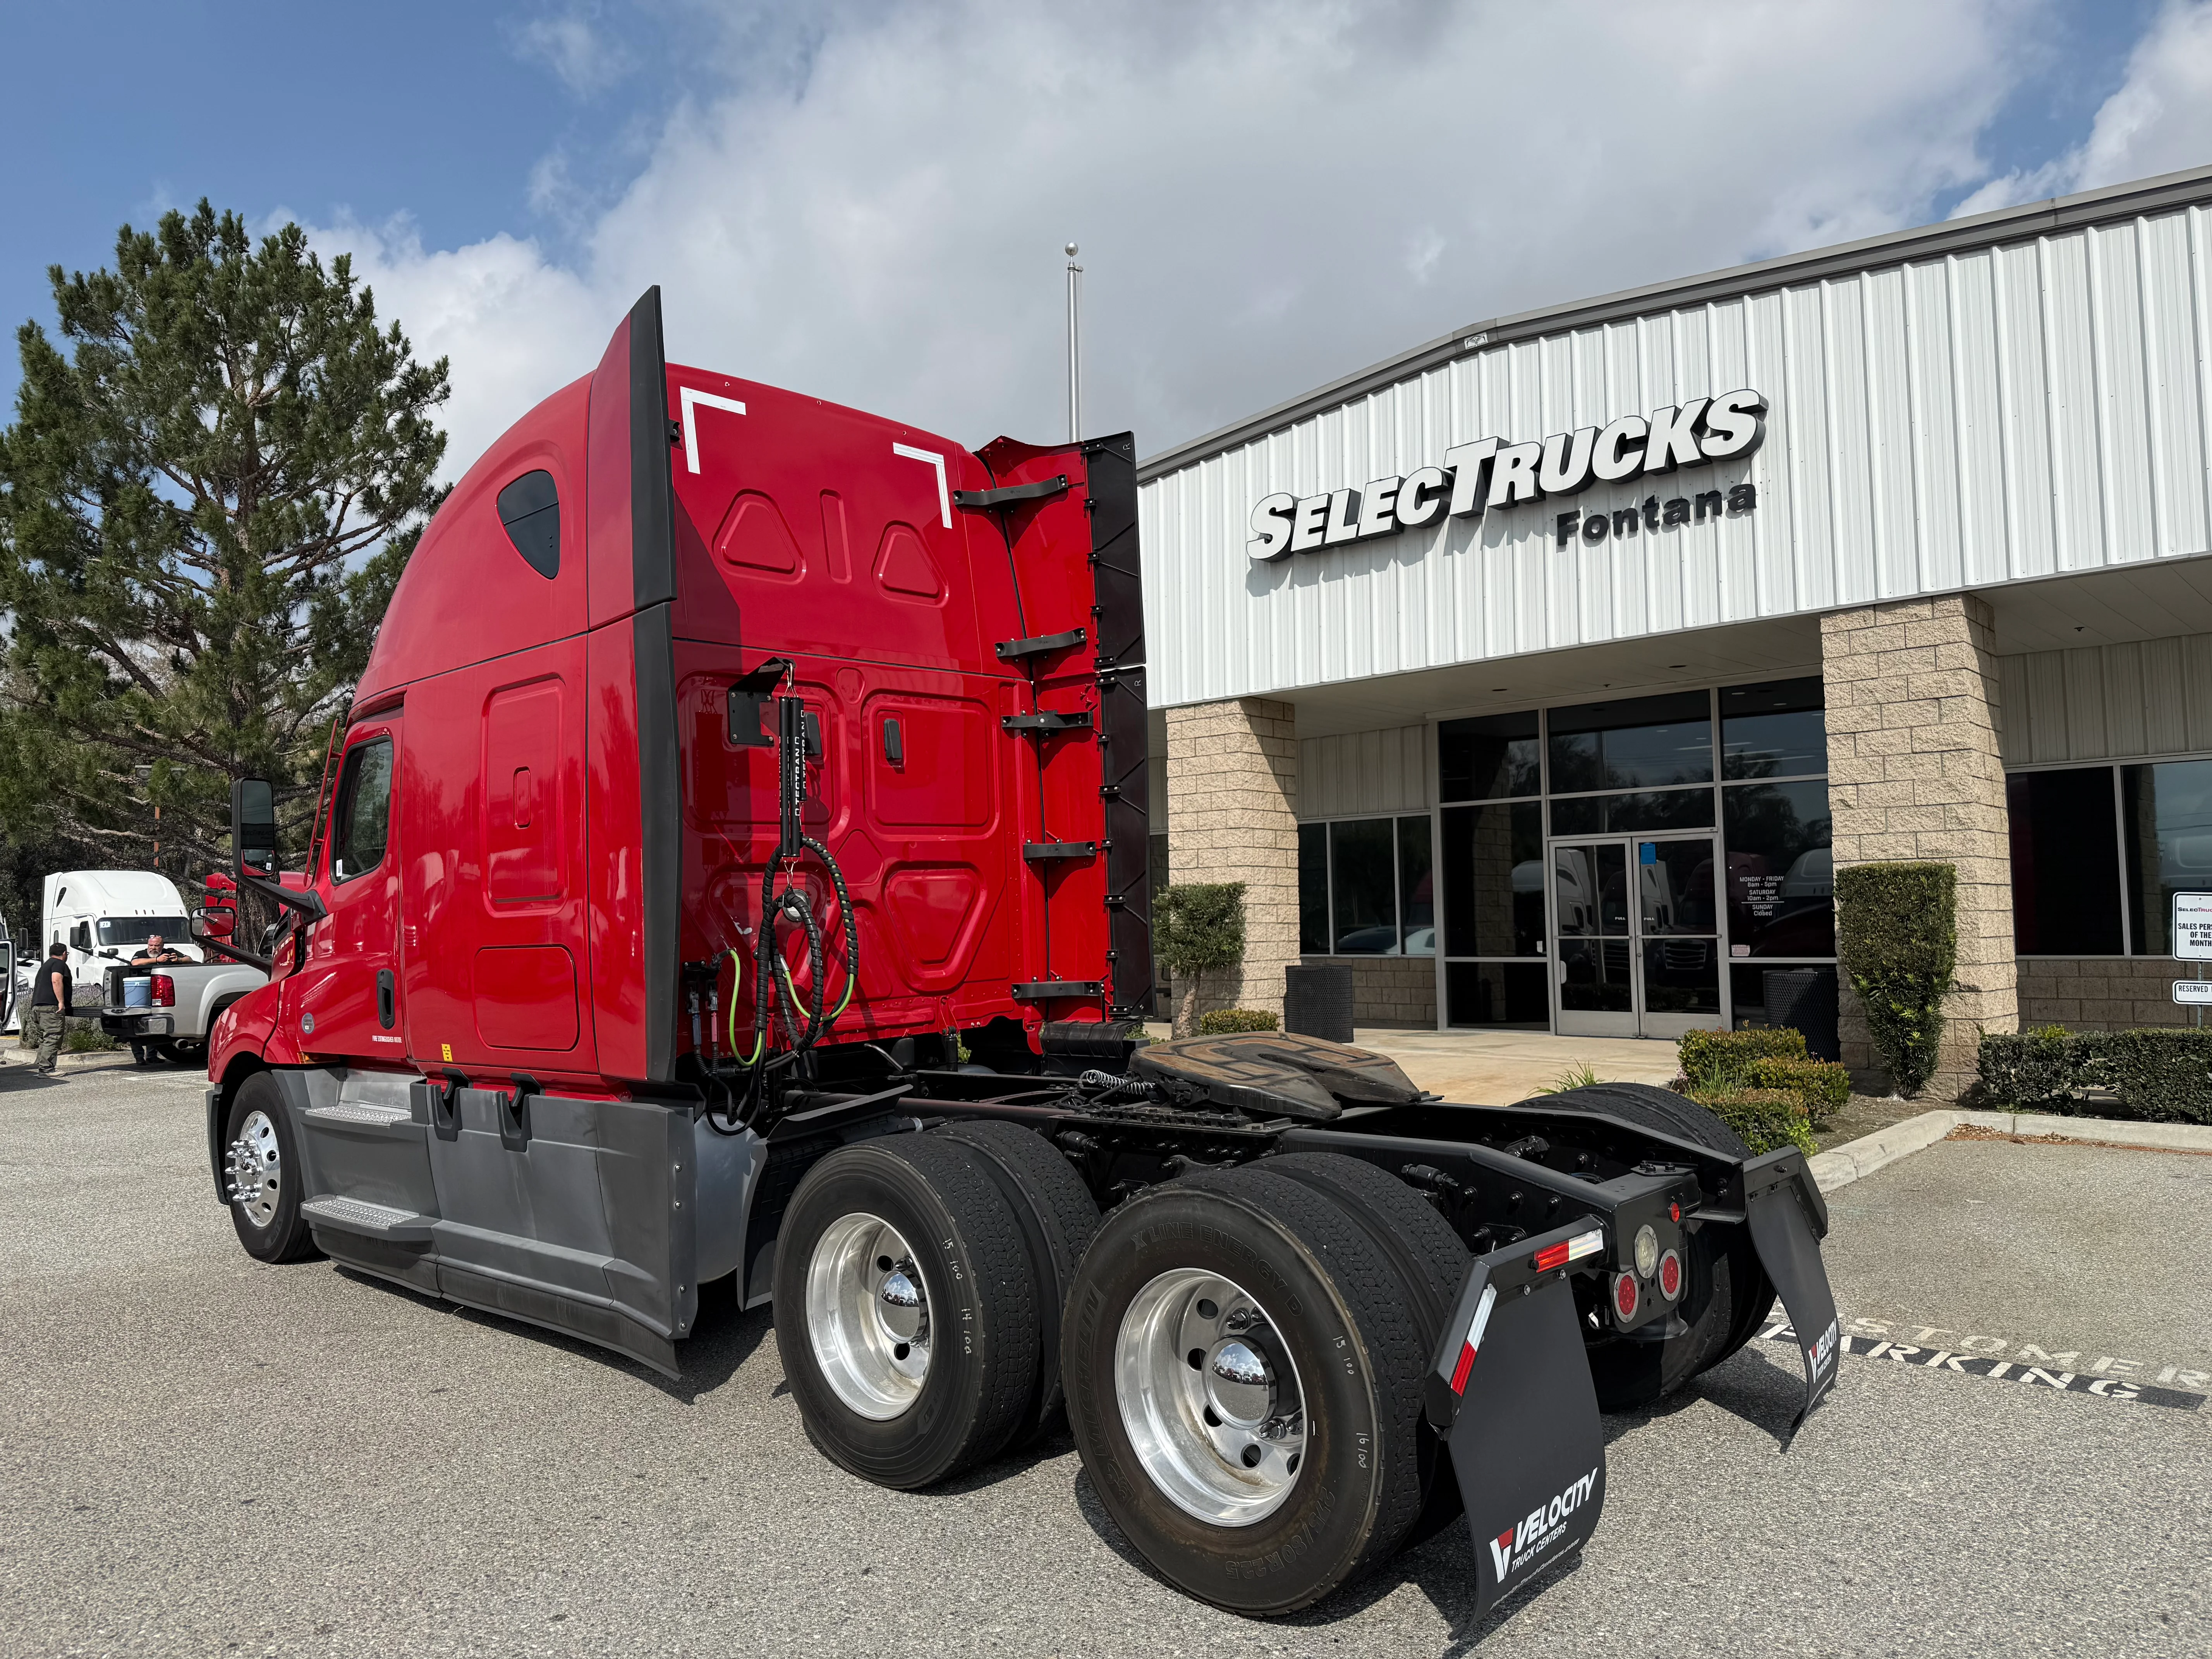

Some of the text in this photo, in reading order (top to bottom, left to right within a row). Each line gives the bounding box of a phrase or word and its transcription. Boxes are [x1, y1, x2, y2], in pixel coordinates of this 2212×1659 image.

[1246, 388, 1769, 562] SELECTRUCKS
[1556, 483, 1757, 546] Fontana
[1149, 1222, 1194, 1243] LINE
[1200, 1224, 1288, 1293] ENERGY
[1285, 1293, 1303, 1317] D
[1077, 1285, 1108, 1456] MICHELIN
[1511, 1521, 1567, 1573] TRUCK CENTERS
[1515, 1467, 1598, 1554] VELOCITY
